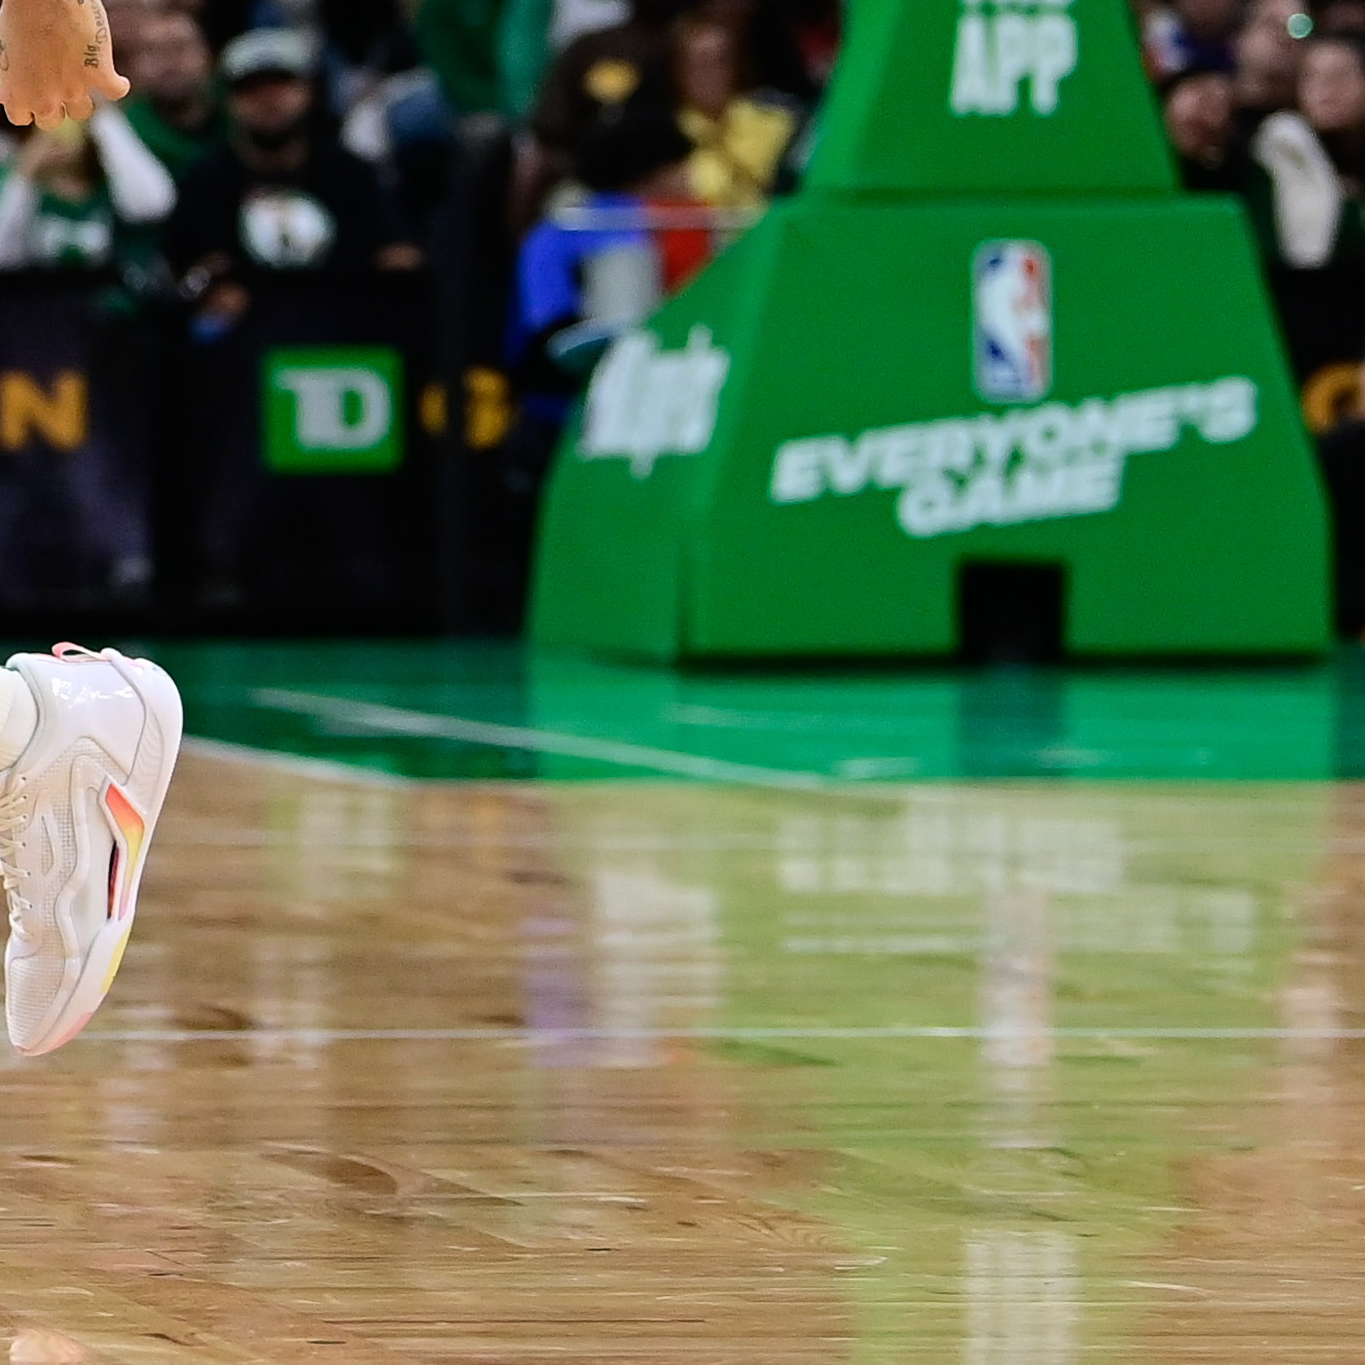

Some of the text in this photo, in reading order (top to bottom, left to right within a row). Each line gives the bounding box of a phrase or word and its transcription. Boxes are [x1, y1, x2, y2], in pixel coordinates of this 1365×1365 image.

[949, 12, 1079, 116] APP
[274, 366, 391, 452] TD
[770, 376, 1259, 504] EVERYONE'S
[896, 457, 1127, 538] GAME
